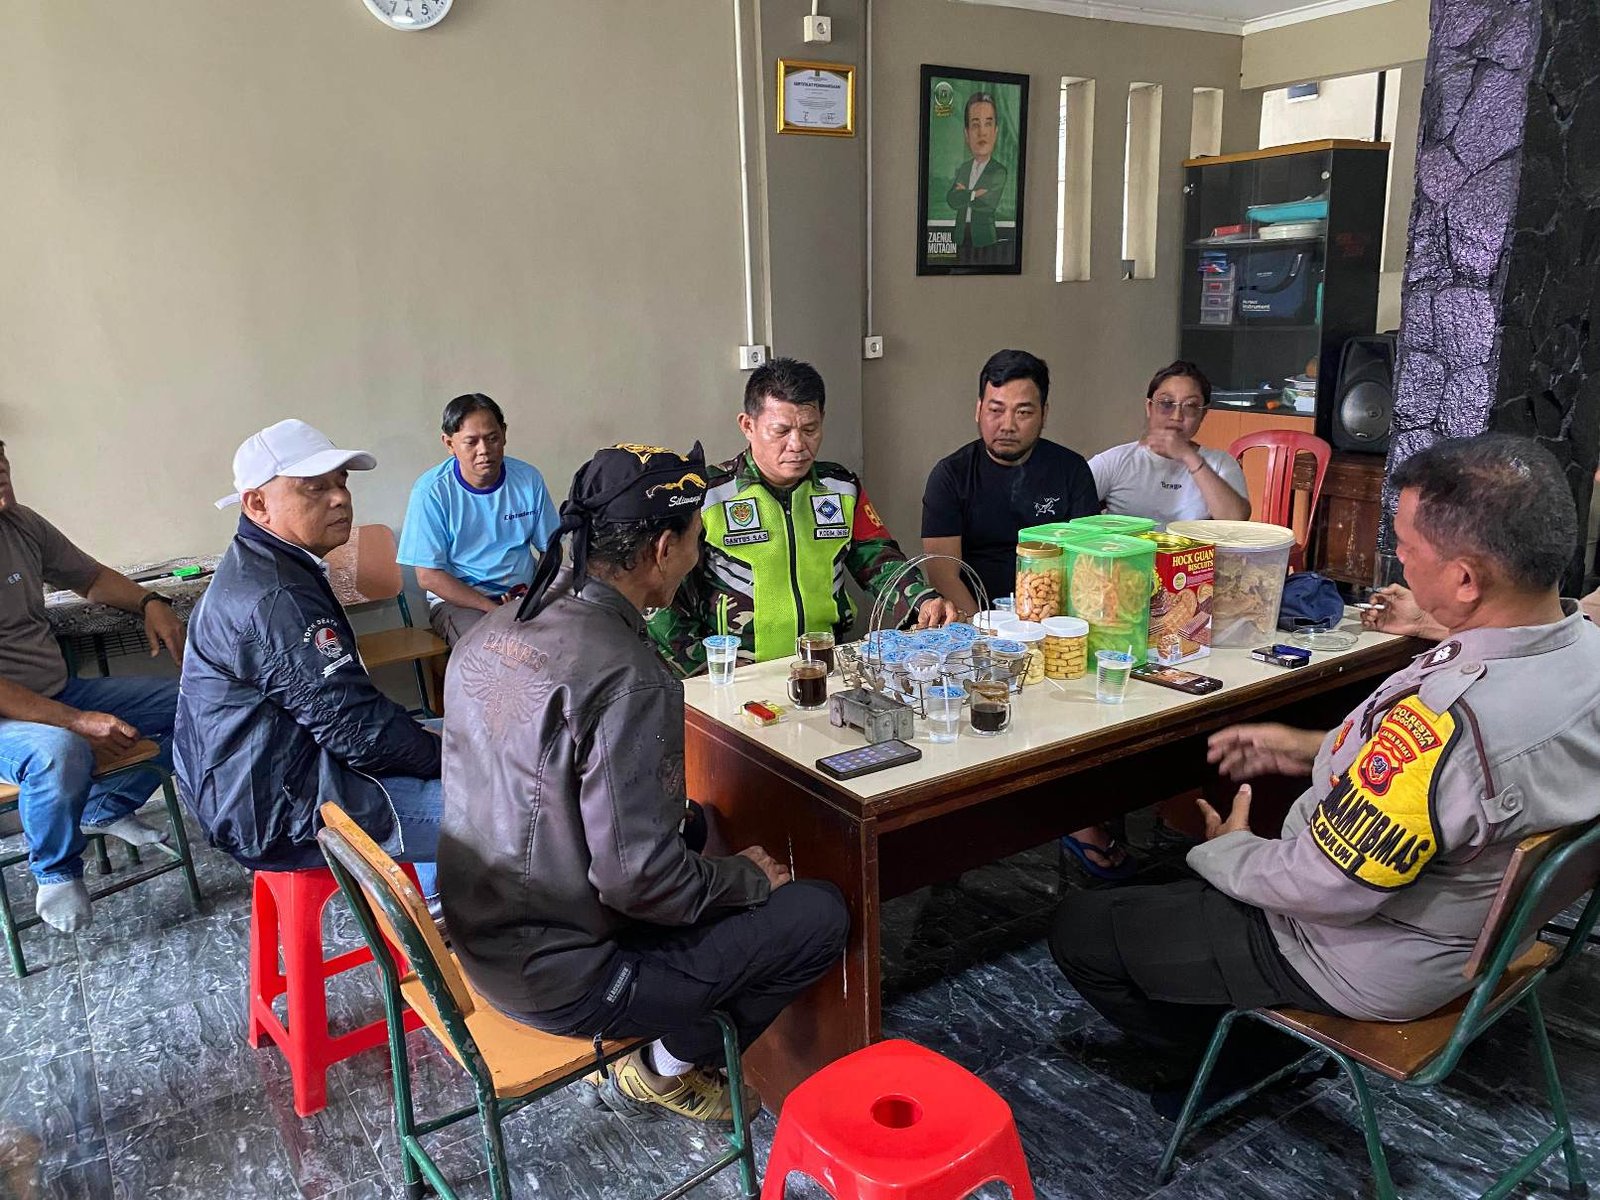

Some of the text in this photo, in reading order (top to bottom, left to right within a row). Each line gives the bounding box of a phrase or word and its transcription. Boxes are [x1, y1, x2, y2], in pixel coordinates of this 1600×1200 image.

[421, 4, 429, 15] 5
[928, 231, 952, 243] ZAENUL
[927, 242, 957, 254] MUTAQIN
[1172, 549, 1214, 567] HOCK GUAN
[1187, 560, 1214, 572] BISCUITS
[1395, 707, 1435, 745] POLRESTA
[1412, 728, 1429, 748] KOTA
